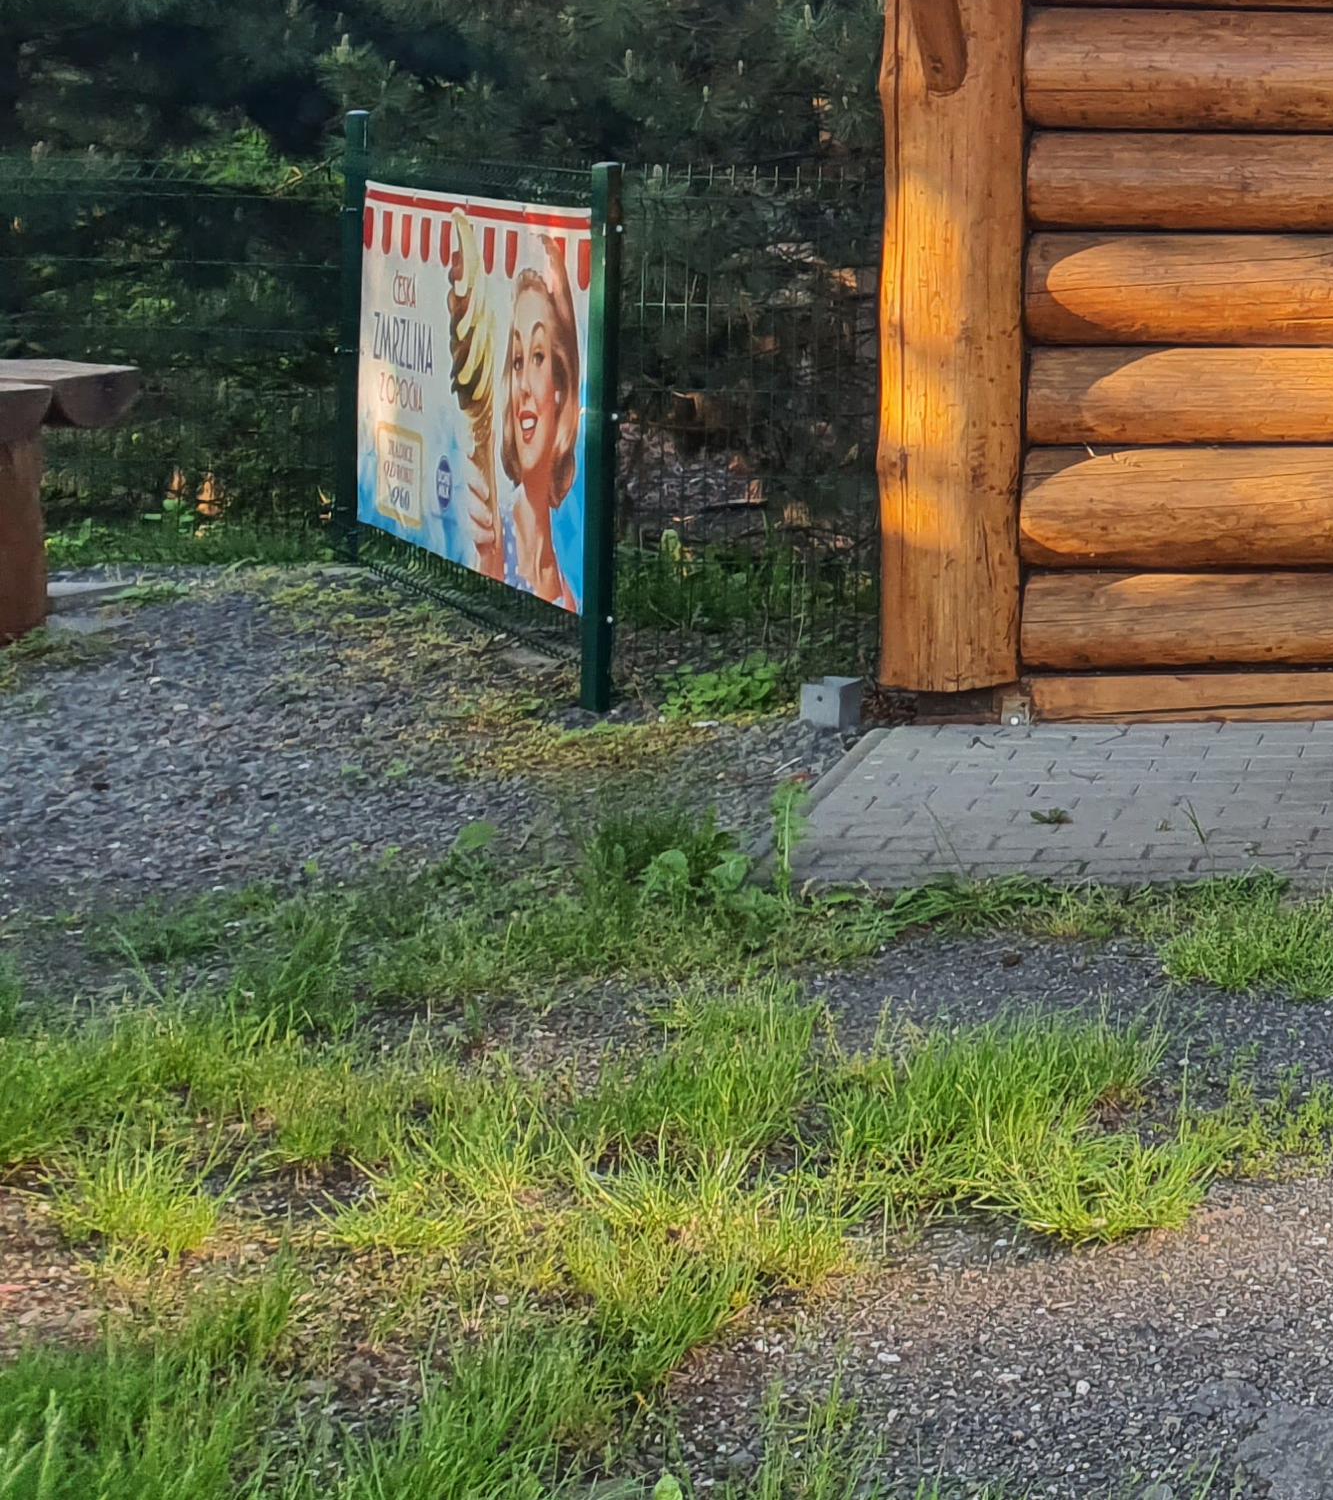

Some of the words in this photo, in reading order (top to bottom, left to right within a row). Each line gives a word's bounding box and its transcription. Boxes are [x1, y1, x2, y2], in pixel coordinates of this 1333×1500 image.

[392, 270, 417, 309] ČESKÁ
[373, 311, 433, 376] ZMRZLINA
[378, 372, 386, 402] Z
